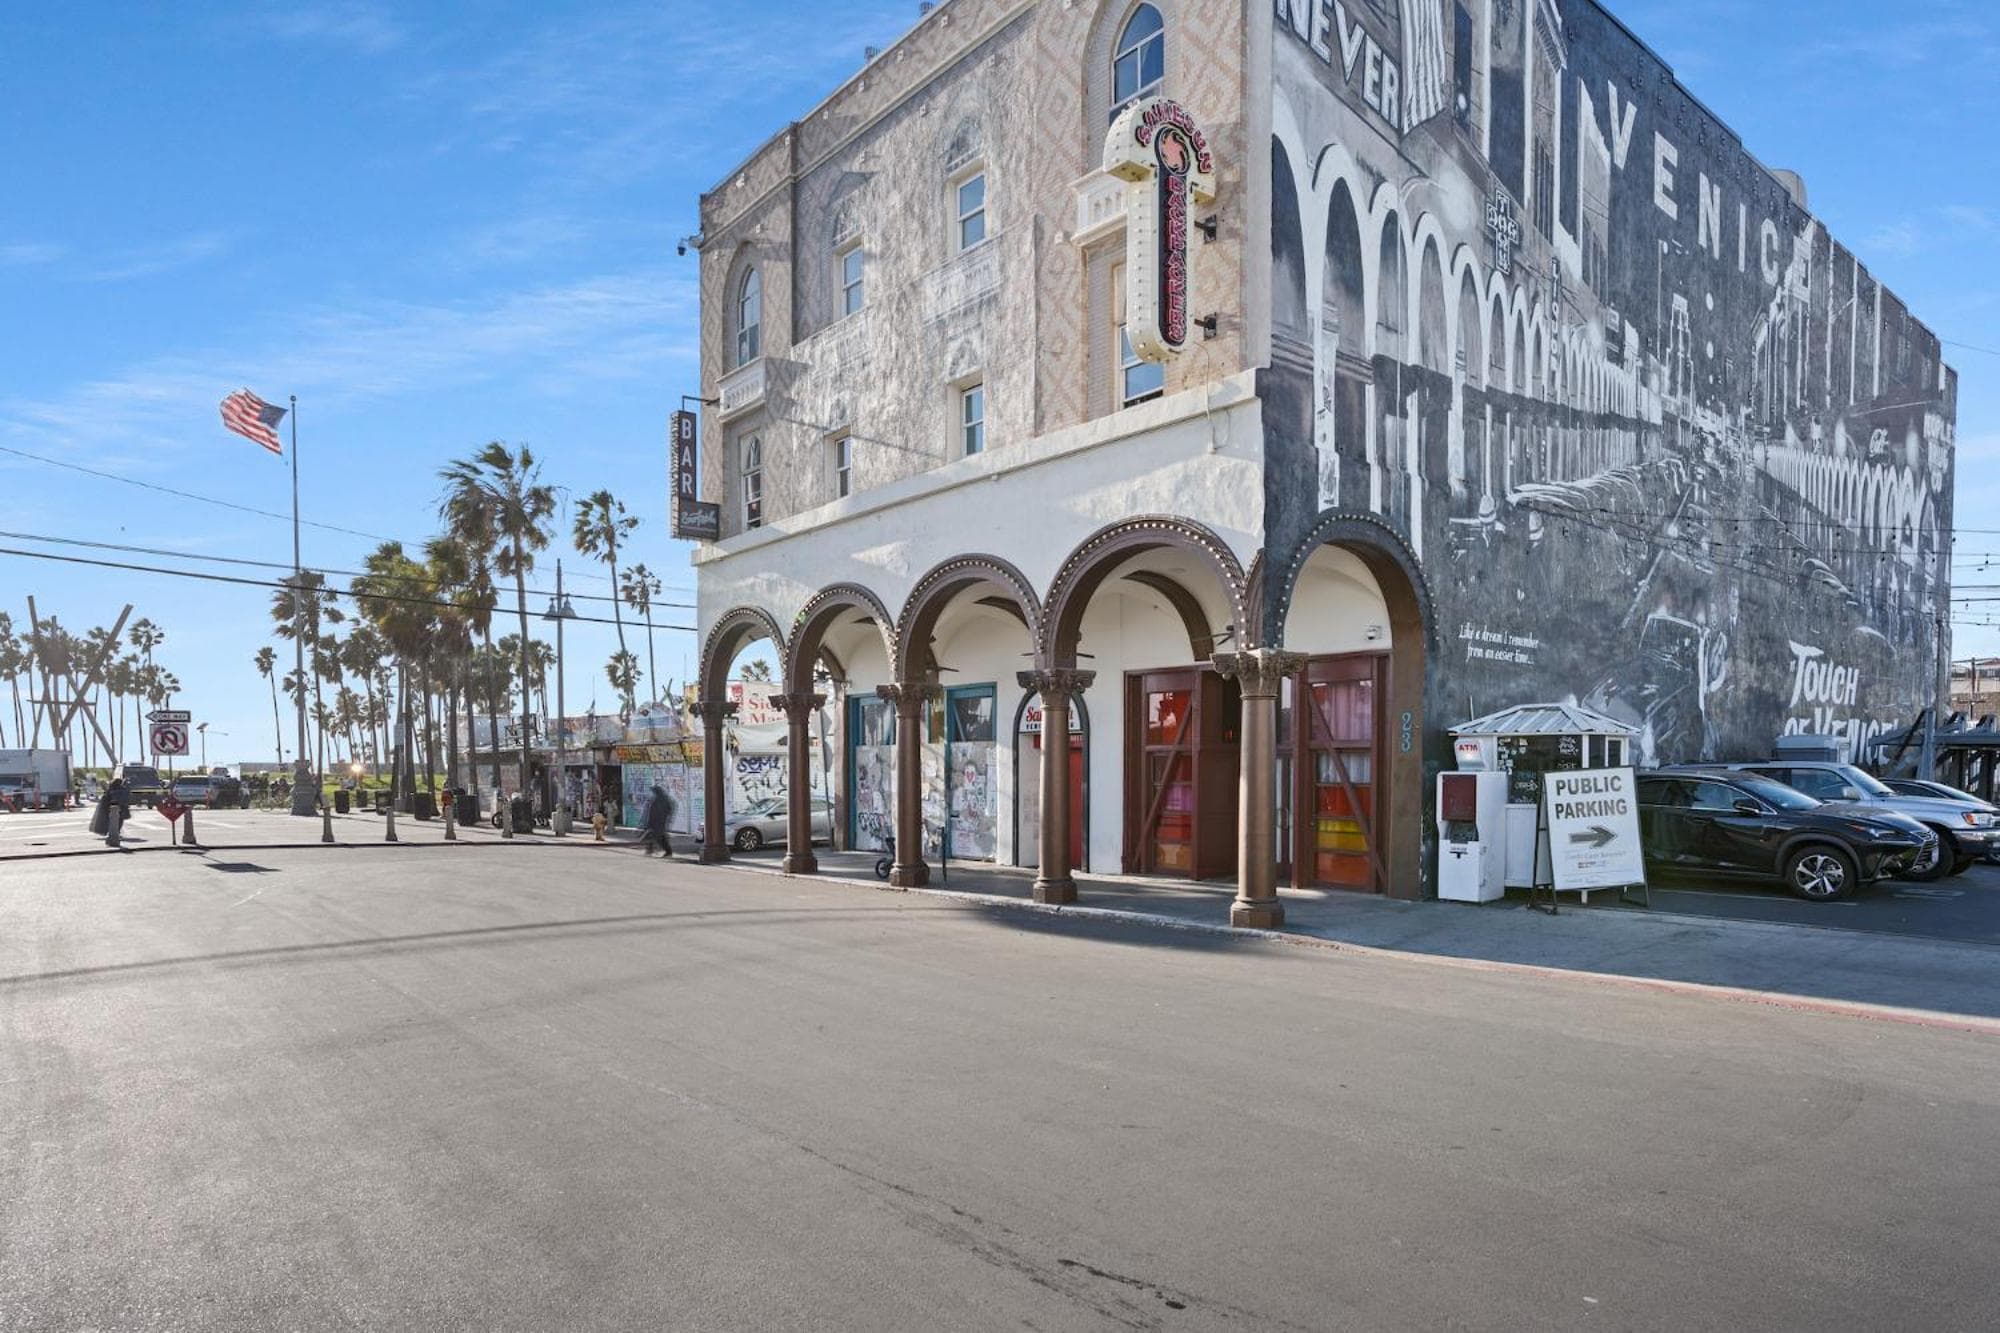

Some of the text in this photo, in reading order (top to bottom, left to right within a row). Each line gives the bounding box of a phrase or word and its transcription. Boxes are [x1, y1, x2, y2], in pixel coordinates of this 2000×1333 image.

[1608, 79, 1812, 302] VENICE
[682, 418, 693, 494] BAR
[1459, 622, 1474, 640] Like
[1482, 624, 1502, 644] dream
[1509, 631, 1539, 649] remember
[1465, 640, 1483, 663] from
[1485, 649, 1494, 659] an
[1495, 650, 1513, 662] easier
[1401, 711, 1412, 753] 23
[1458, 744, 1478, 752] ATM
[1556, 776, 1622, 796] PUBLIC
[1555, 799, 1628, 820] PARKING
